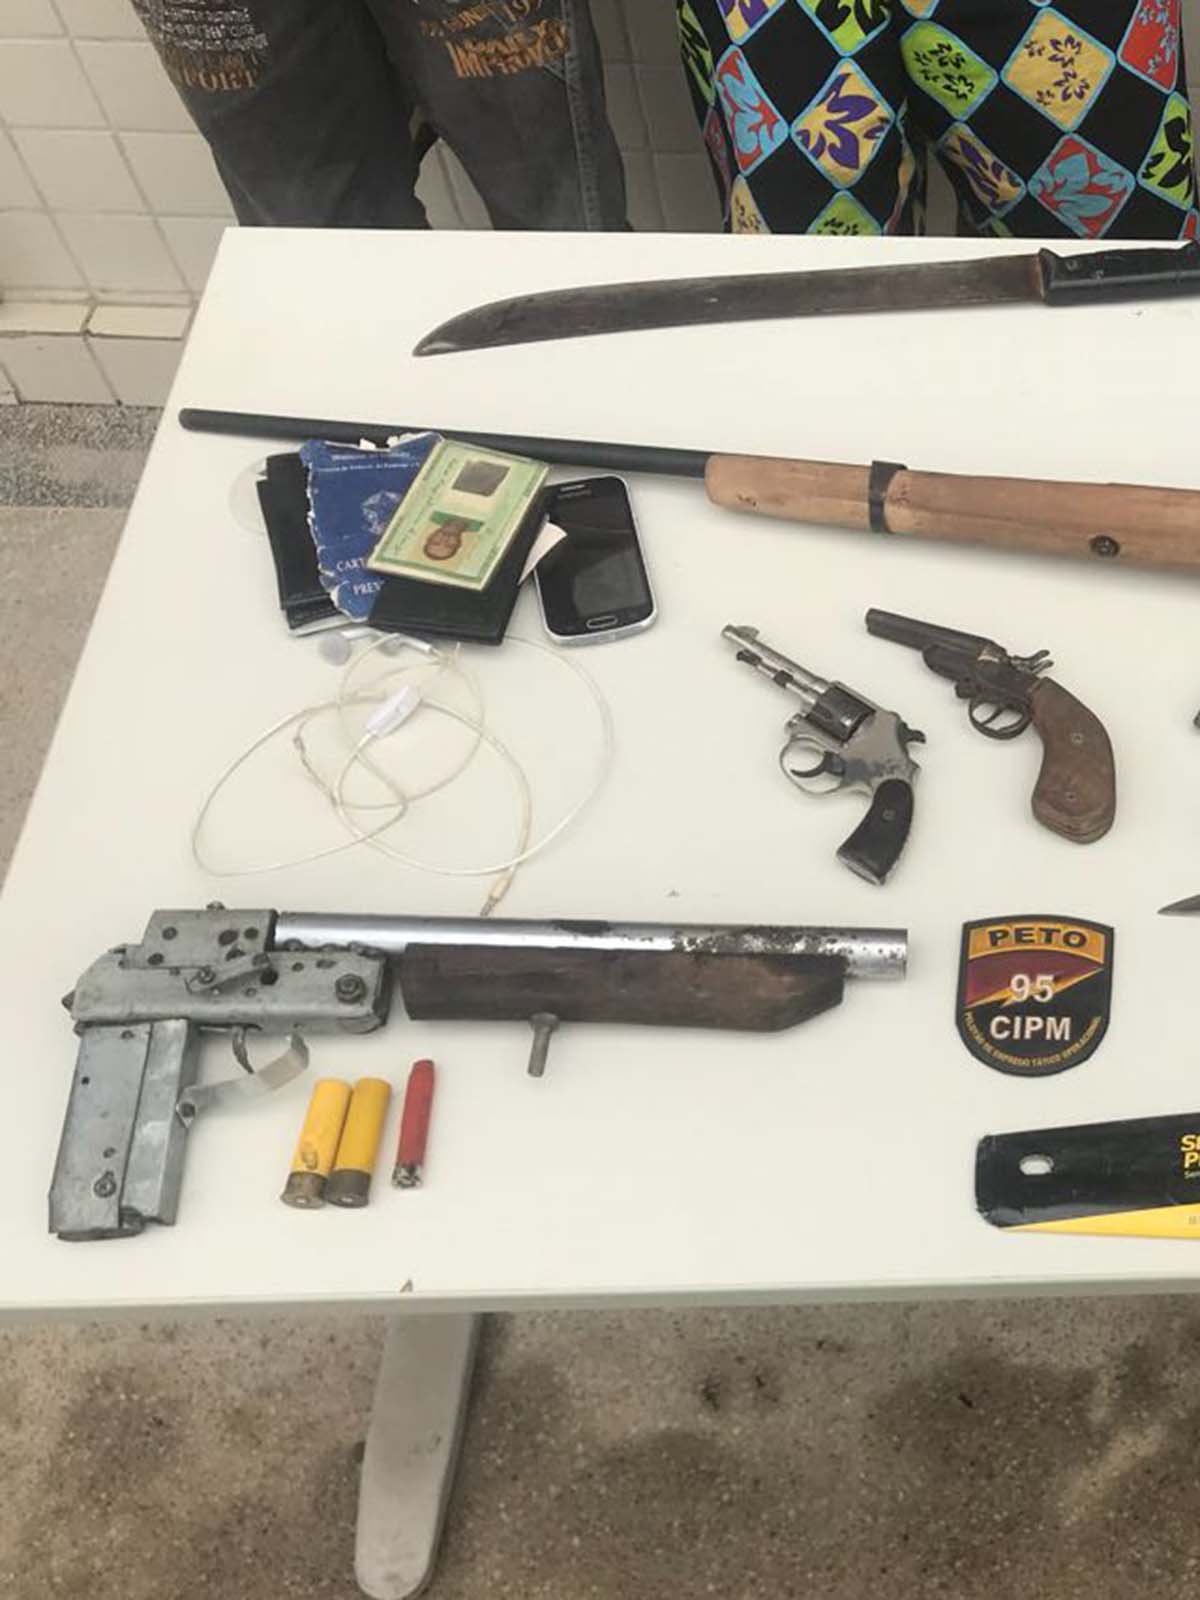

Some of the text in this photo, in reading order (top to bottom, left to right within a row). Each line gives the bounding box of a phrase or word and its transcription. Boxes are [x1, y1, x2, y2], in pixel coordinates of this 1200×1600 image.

[988, 927, 1088, 948] PETO
[1010, 974, 1055, 1003] 95
[989, 1015, 1072, 1041] CIPM
